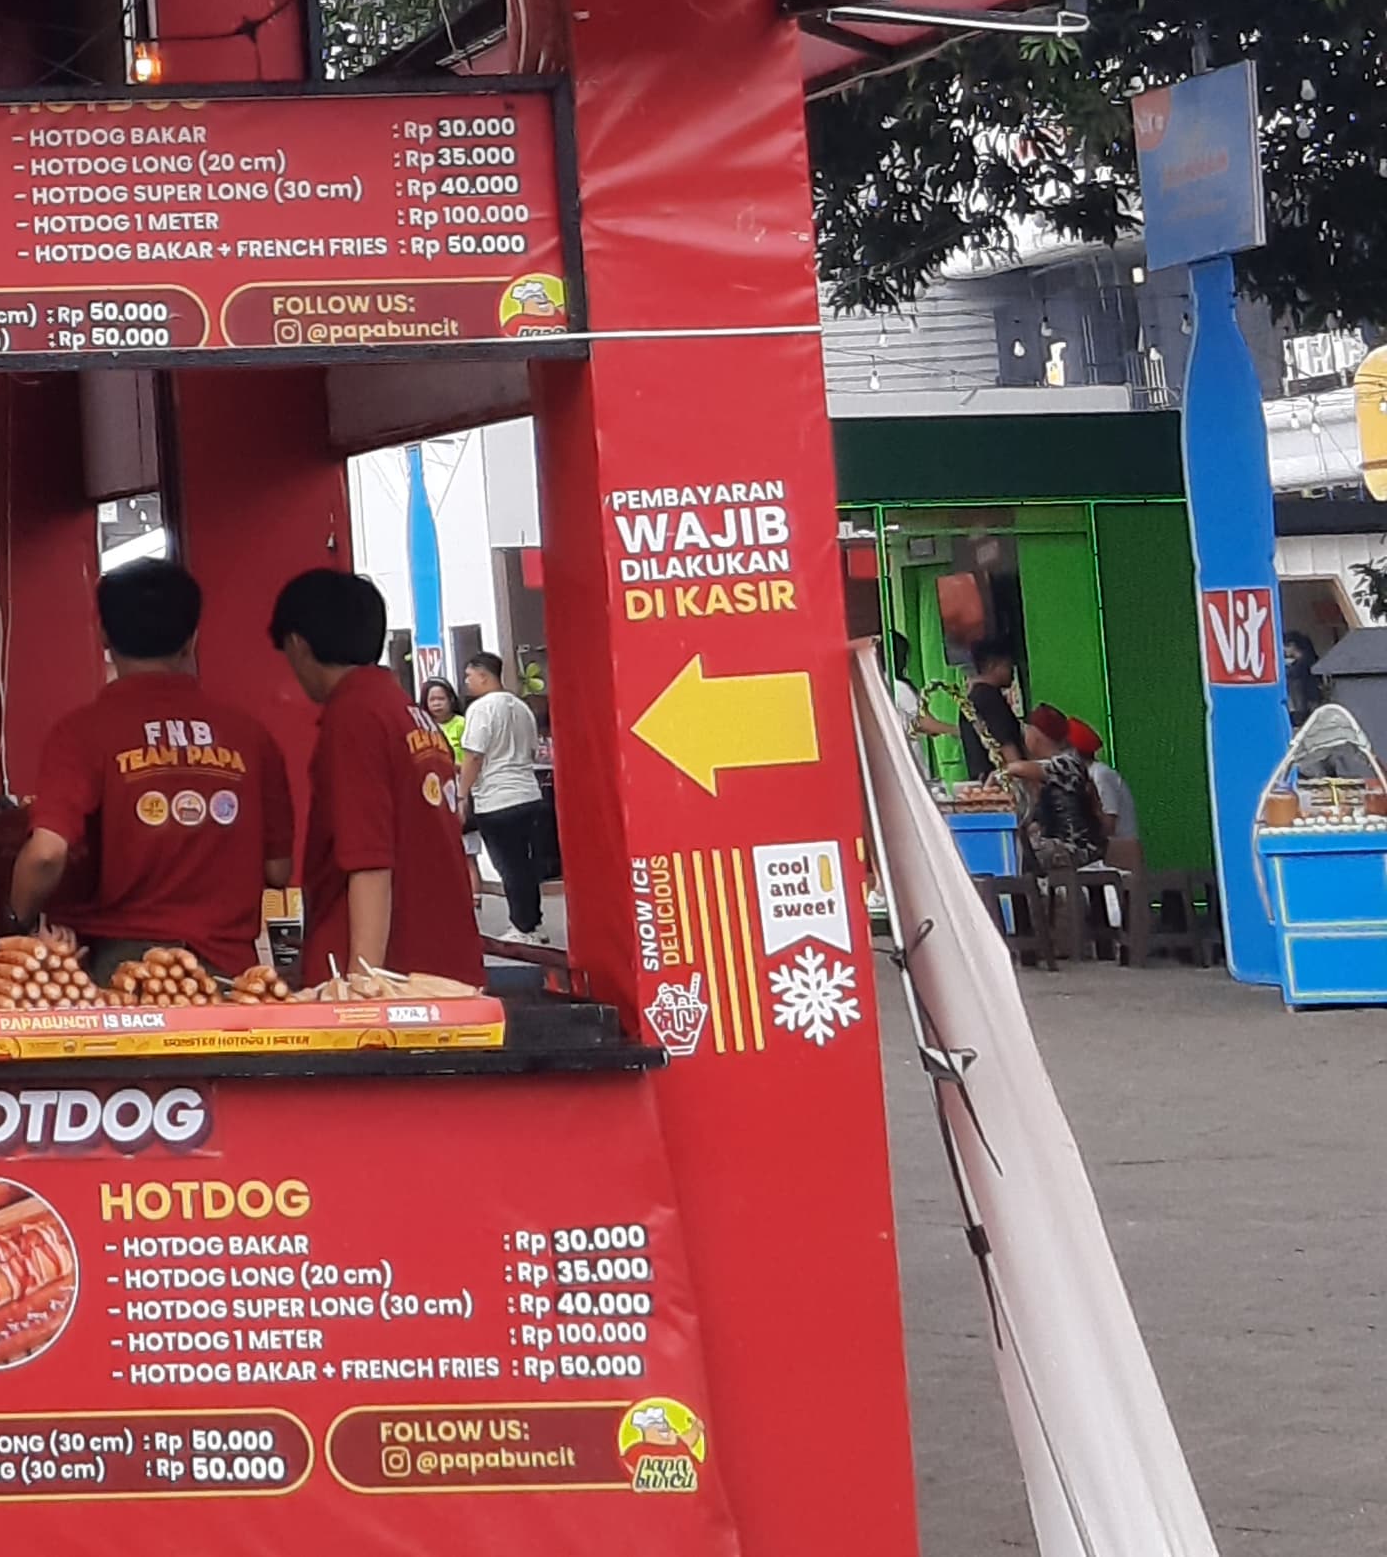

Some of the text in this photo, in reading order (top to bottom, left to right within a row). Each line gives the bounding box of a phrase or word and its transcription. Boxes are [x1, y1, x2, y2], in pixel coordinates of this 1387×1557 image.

[35, 243, 132, 263] HOTDOG
[136, 241, 214, 260] BAKAR
[236, 238, 325, 258] FRENCH
[328, 237, 388, 257] FRIES
[448, 234, 525, 254] 50.000
[273, 294, 416, 315] FOLLOW US:
[91, 327, 169, 347] 50.000
[306, 318, 460, 345] @papabuncit
[611, 480, 785, 511] PEMBAYARAN
[614, 504, 790, 554] WAJIB
[619, 549, 790, 584] DILAKUKAN
[624, 579, 797, 622] DI KASIR
[1208, 589, 1268, 679] Vit
[115, 746, 246, 775] TEAM PAPA
[767, 855, 810, 876] cool
[769, 877, 811, 897] and
[631, 857, 660, 971] SNOW ICE
[650, 854, 681, 966] DELICIOUS
[772, 898, 836, 919] sweet
[102, 1014, 119, 1029] IS
[122, 1013, 165, 1029] BACK
[100, 1179, 311, 1221] HOTDOG
[123, 1236, 224, 1258] HOTDOG
[228, 1234, 309, 1256] BAKAR
[553, 1225, 645, 1253] 30.000
[380, 1419, 530, 1443] FOLLOW US:
[416, 1446, 576, 1475] @papabuncit
